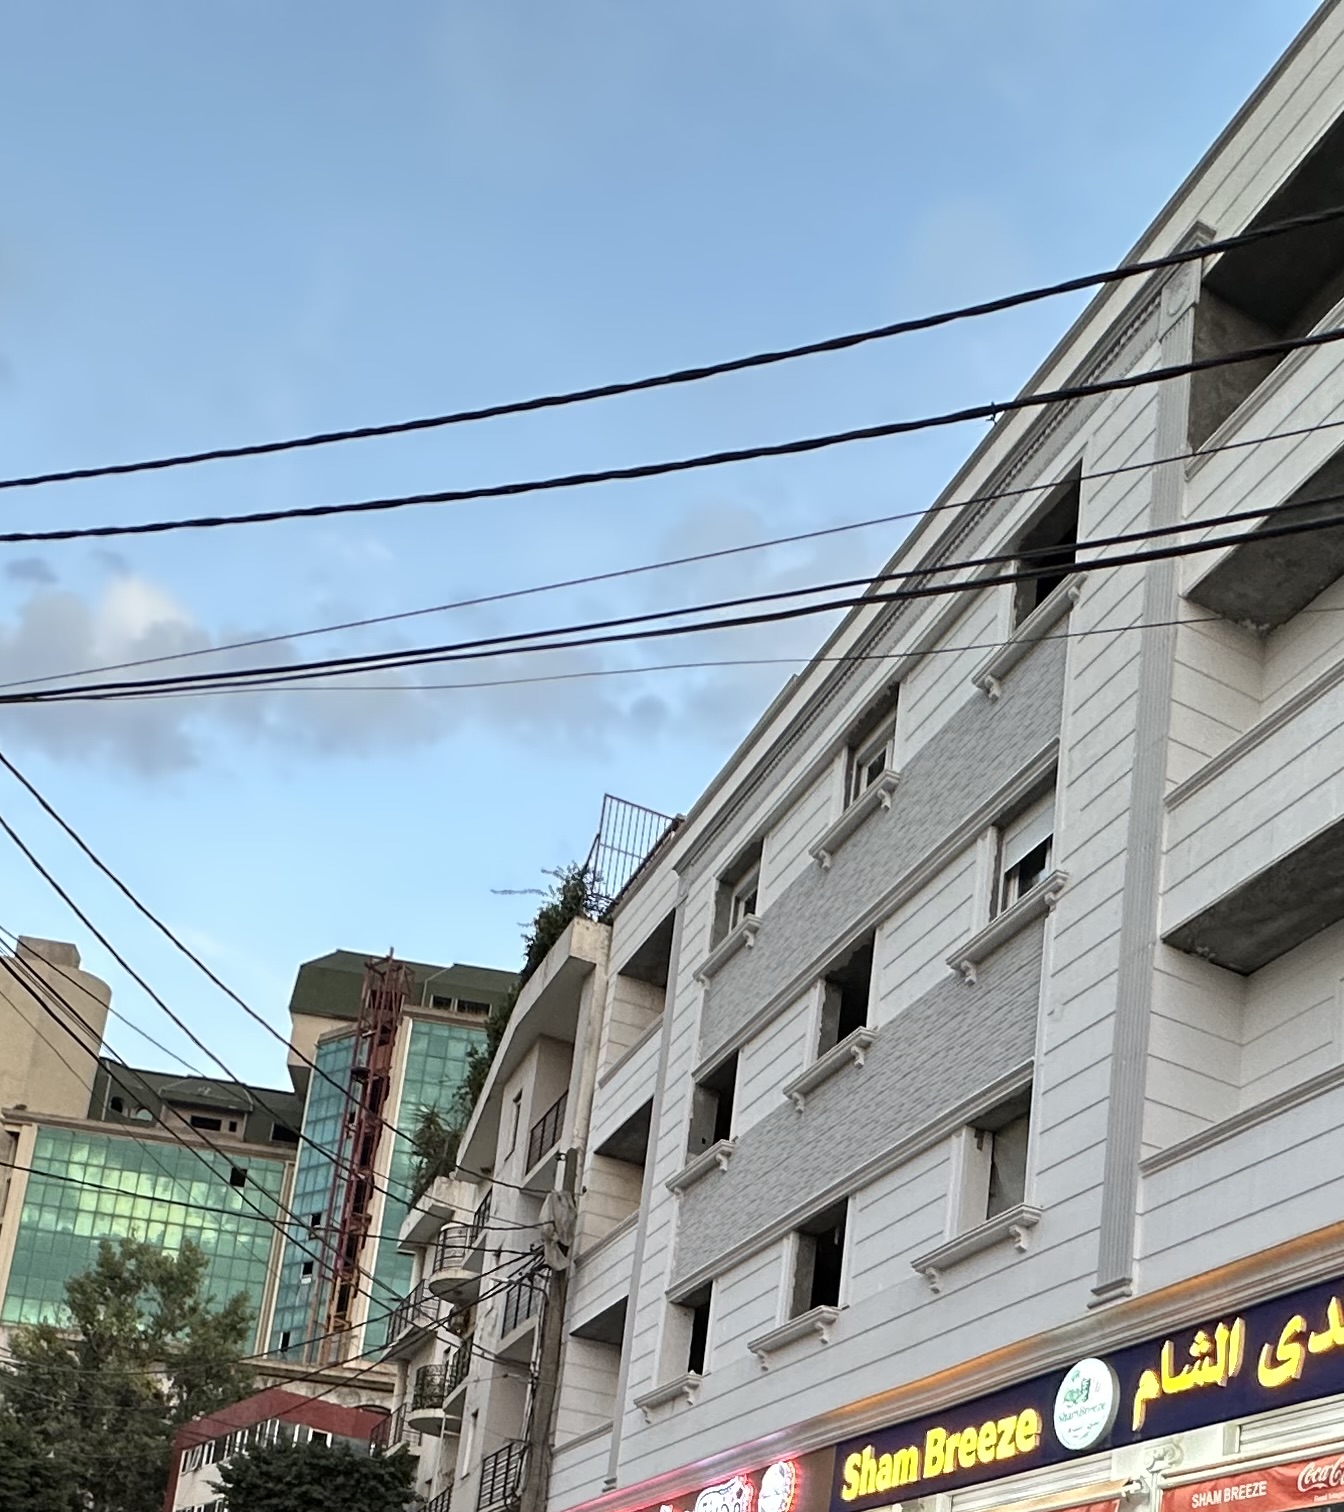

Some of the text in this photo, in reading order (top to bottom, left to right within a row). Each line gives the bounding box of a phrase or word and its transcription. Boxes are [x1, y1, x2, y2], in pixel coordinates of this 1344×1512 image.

[1131, 1317, 1245, 1431] الشام
[841, 1408, 1042, 1501] Sham Breeze
[1191, 1481, 1267, 1508] SHAM BREEZE
